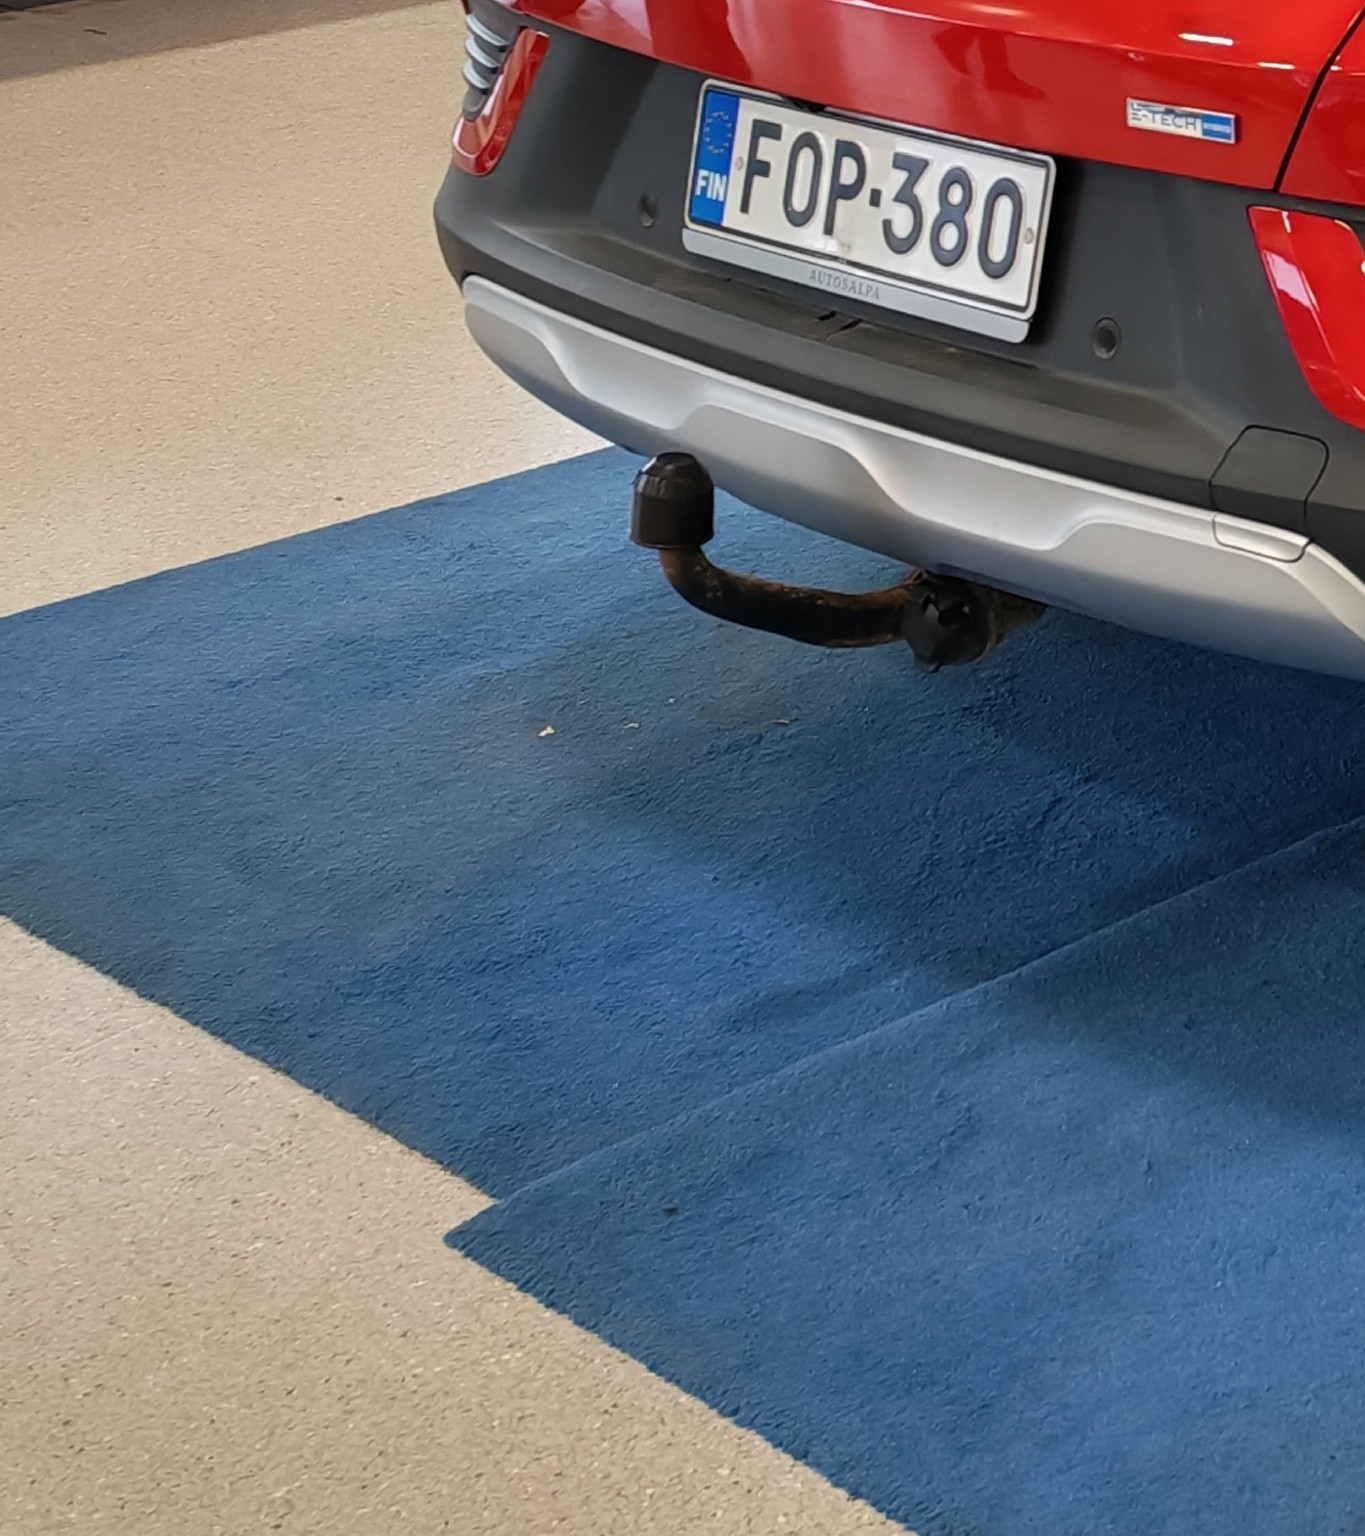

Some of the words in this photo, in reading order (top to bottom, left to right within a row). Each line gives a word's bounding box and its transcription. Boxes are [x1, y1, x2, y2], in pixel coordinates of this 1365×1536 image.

[694, 168, 728, 203] FIN
[738, 118, 1024, 281] FOP-380
[809, 268, 881, 302] AUTOSALPA
